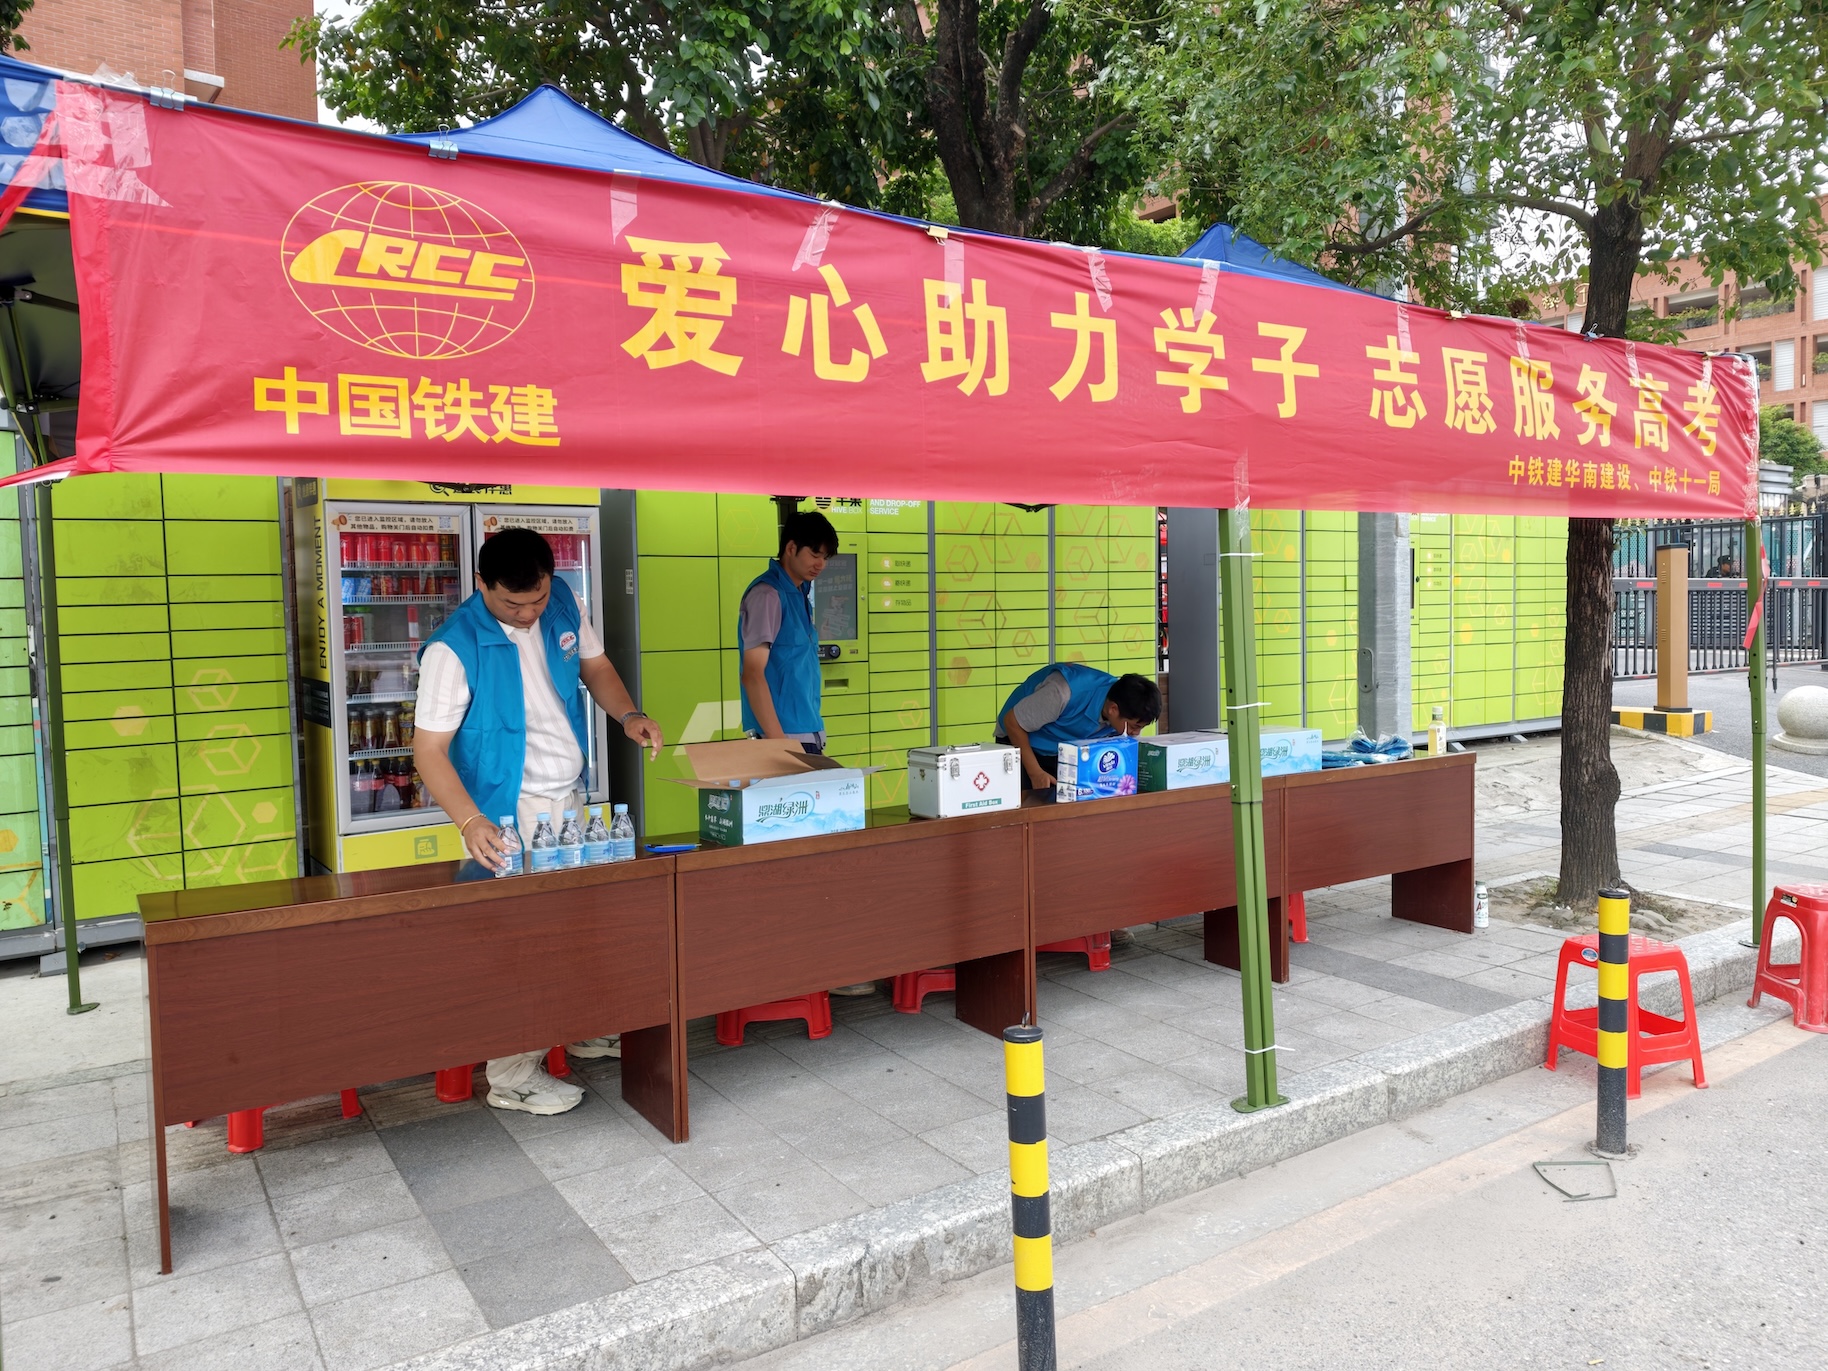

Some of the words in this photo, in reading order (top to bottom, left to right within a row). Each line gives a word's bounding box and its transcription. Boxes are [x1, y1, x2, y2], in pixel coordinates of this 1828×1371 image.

[290, 229, 526, 301] CRCC
[620, 235, 1319, 418] 爱心助力学子
[1365, 335, 1722, 457] 志愿服务高考
[253, 366, 561, 446] 中国铁建
[1508, 455, 1721, 496] 中铁建华南建设、中铁十一局
[869, 507, 899, 515] SERVICE
[870, 499, 885, 507] AND
[886, 499, 921, 507] DROP-OFF
[314, 516, 324, 591] MOMENT
[317, 597, 324, 608] A
[318, 617, 327, 669] ENJOY
